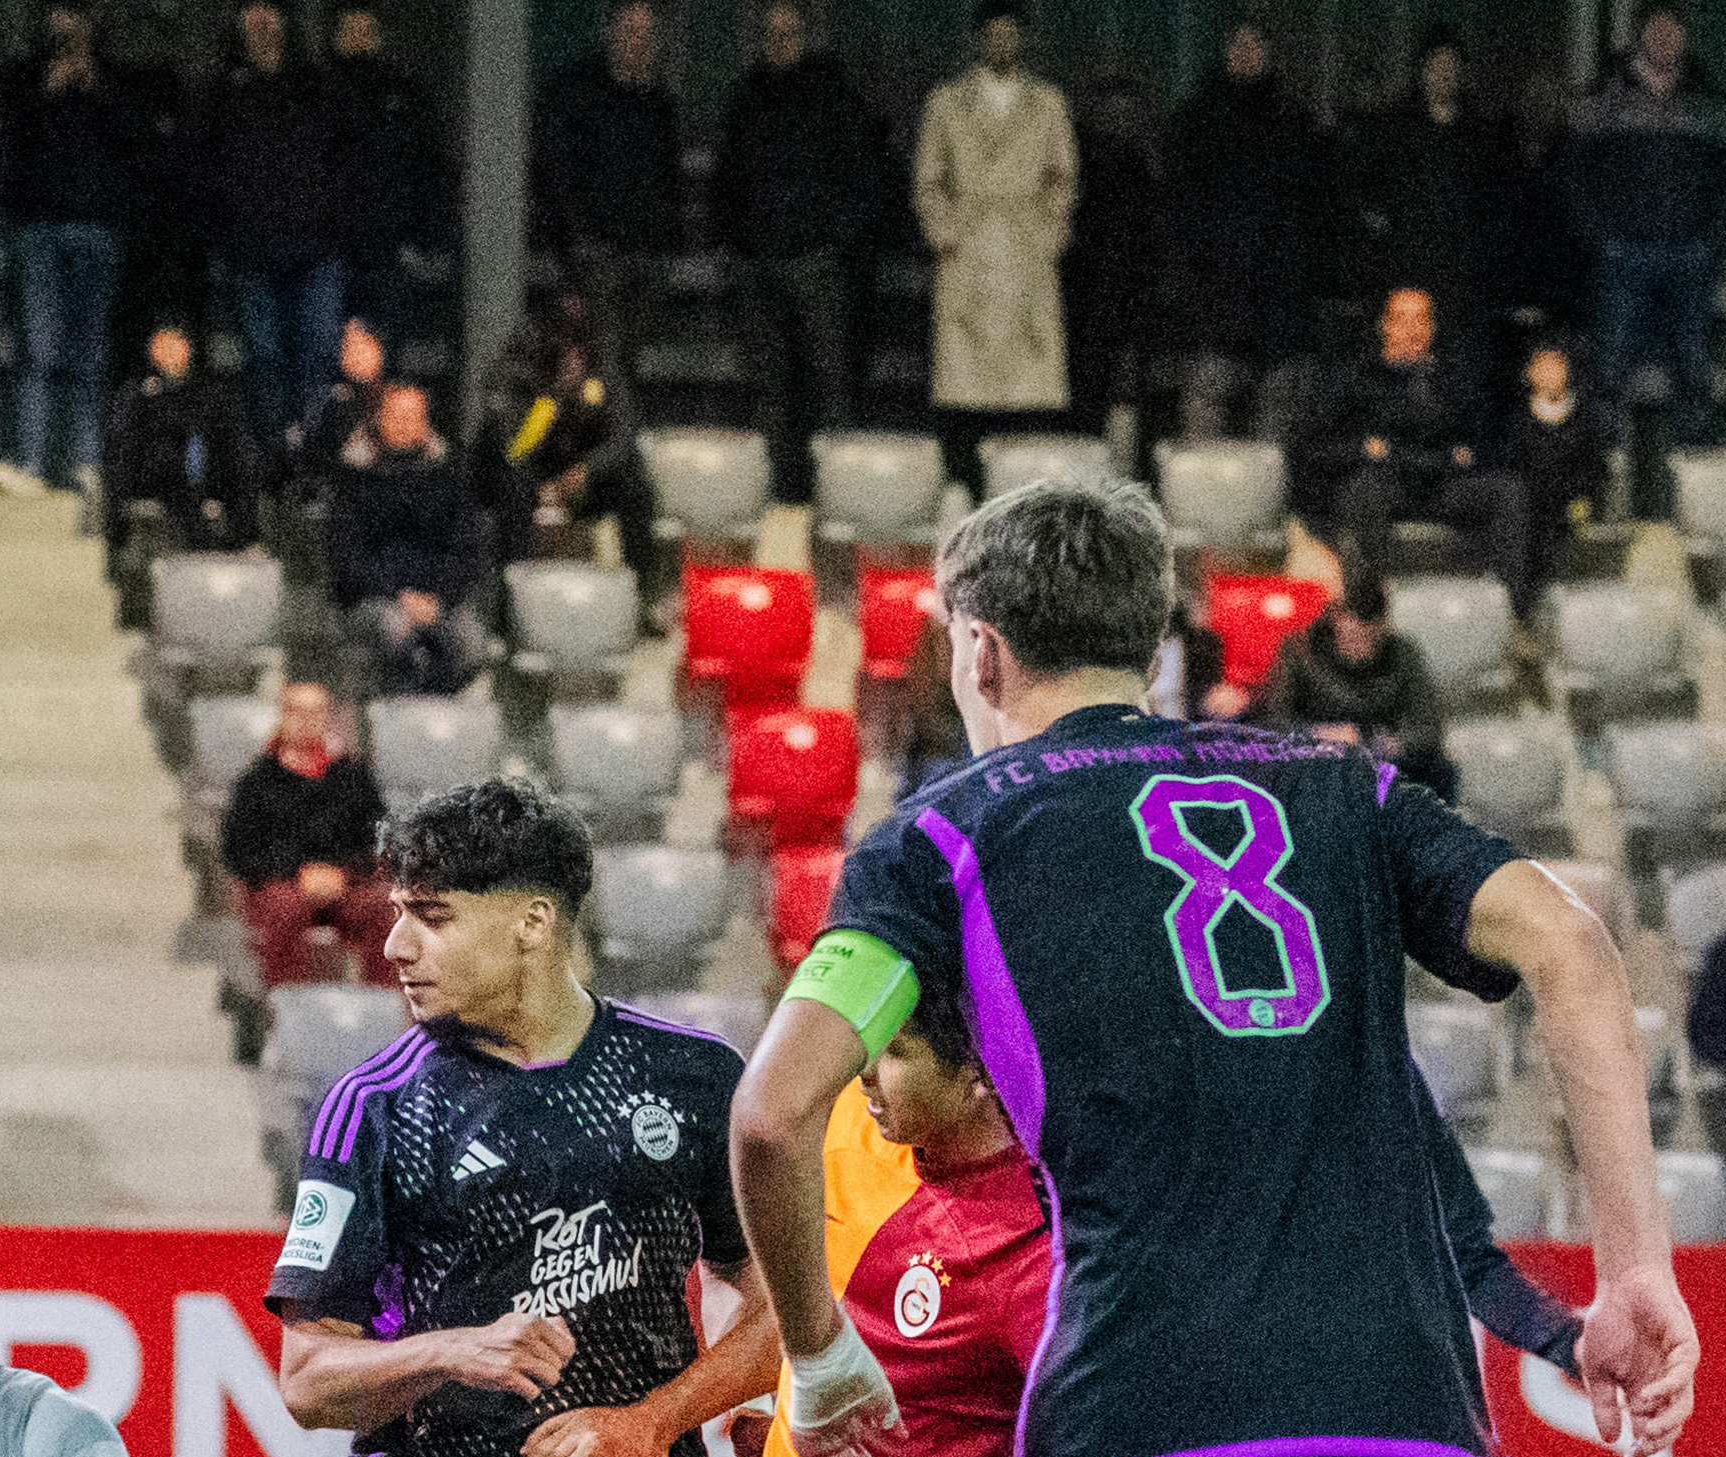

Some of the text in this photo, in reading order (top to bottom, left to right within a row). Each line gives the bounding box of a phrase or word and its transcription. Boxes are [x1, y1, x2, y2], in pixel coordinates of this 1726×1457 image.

[983, 760, 1034, 794] FC
[1129, 774, 1331, 1037] 8
[287, 1237, 326, 1251] OREN-
[530, 1200, 607, 1258] ROT
[530, 1224, 601, 1285] GEGEN
[511, 1237, 642, 1319] RASSISMUS
